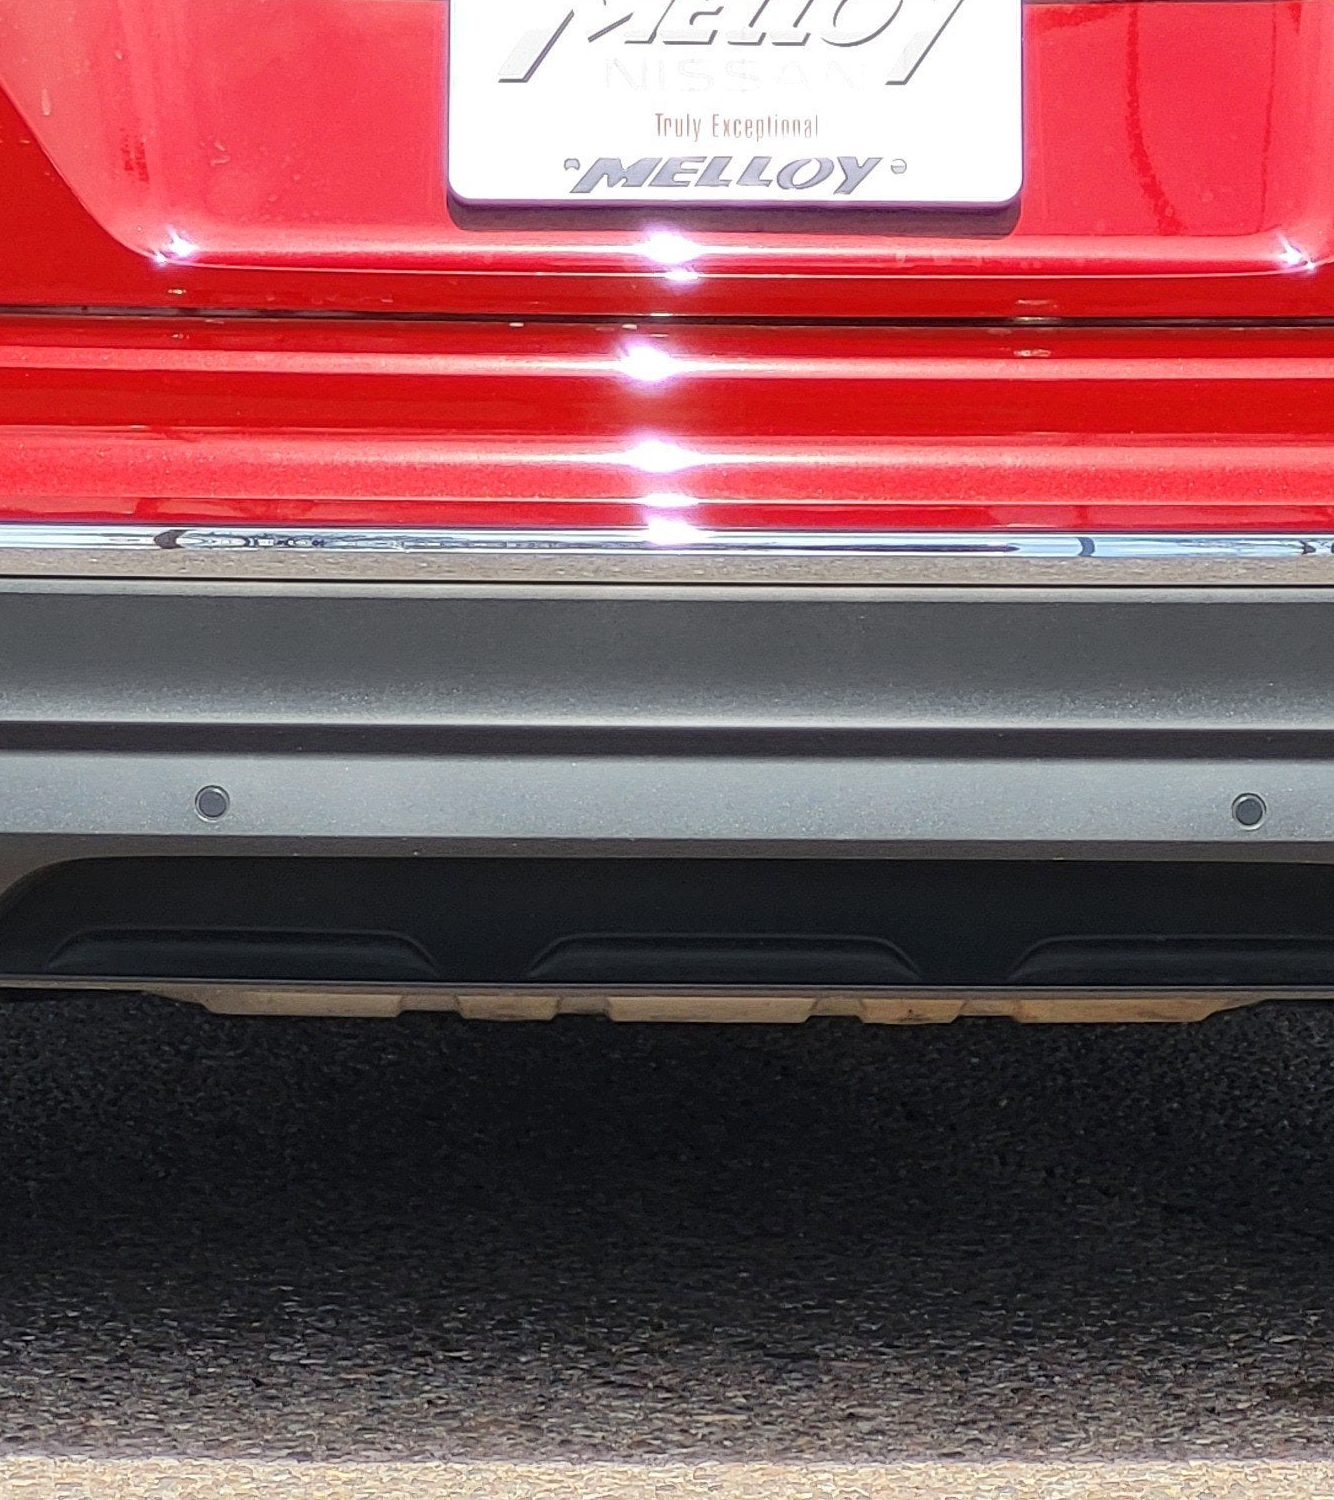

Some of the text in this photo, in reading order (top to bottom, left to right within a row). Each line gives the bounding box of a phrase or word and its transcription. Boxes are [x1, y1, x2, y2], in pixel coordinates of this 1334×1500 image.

[654, 112, 819, 142] Truly Exceptional
[569, 156, 884, 195] MELLOY
